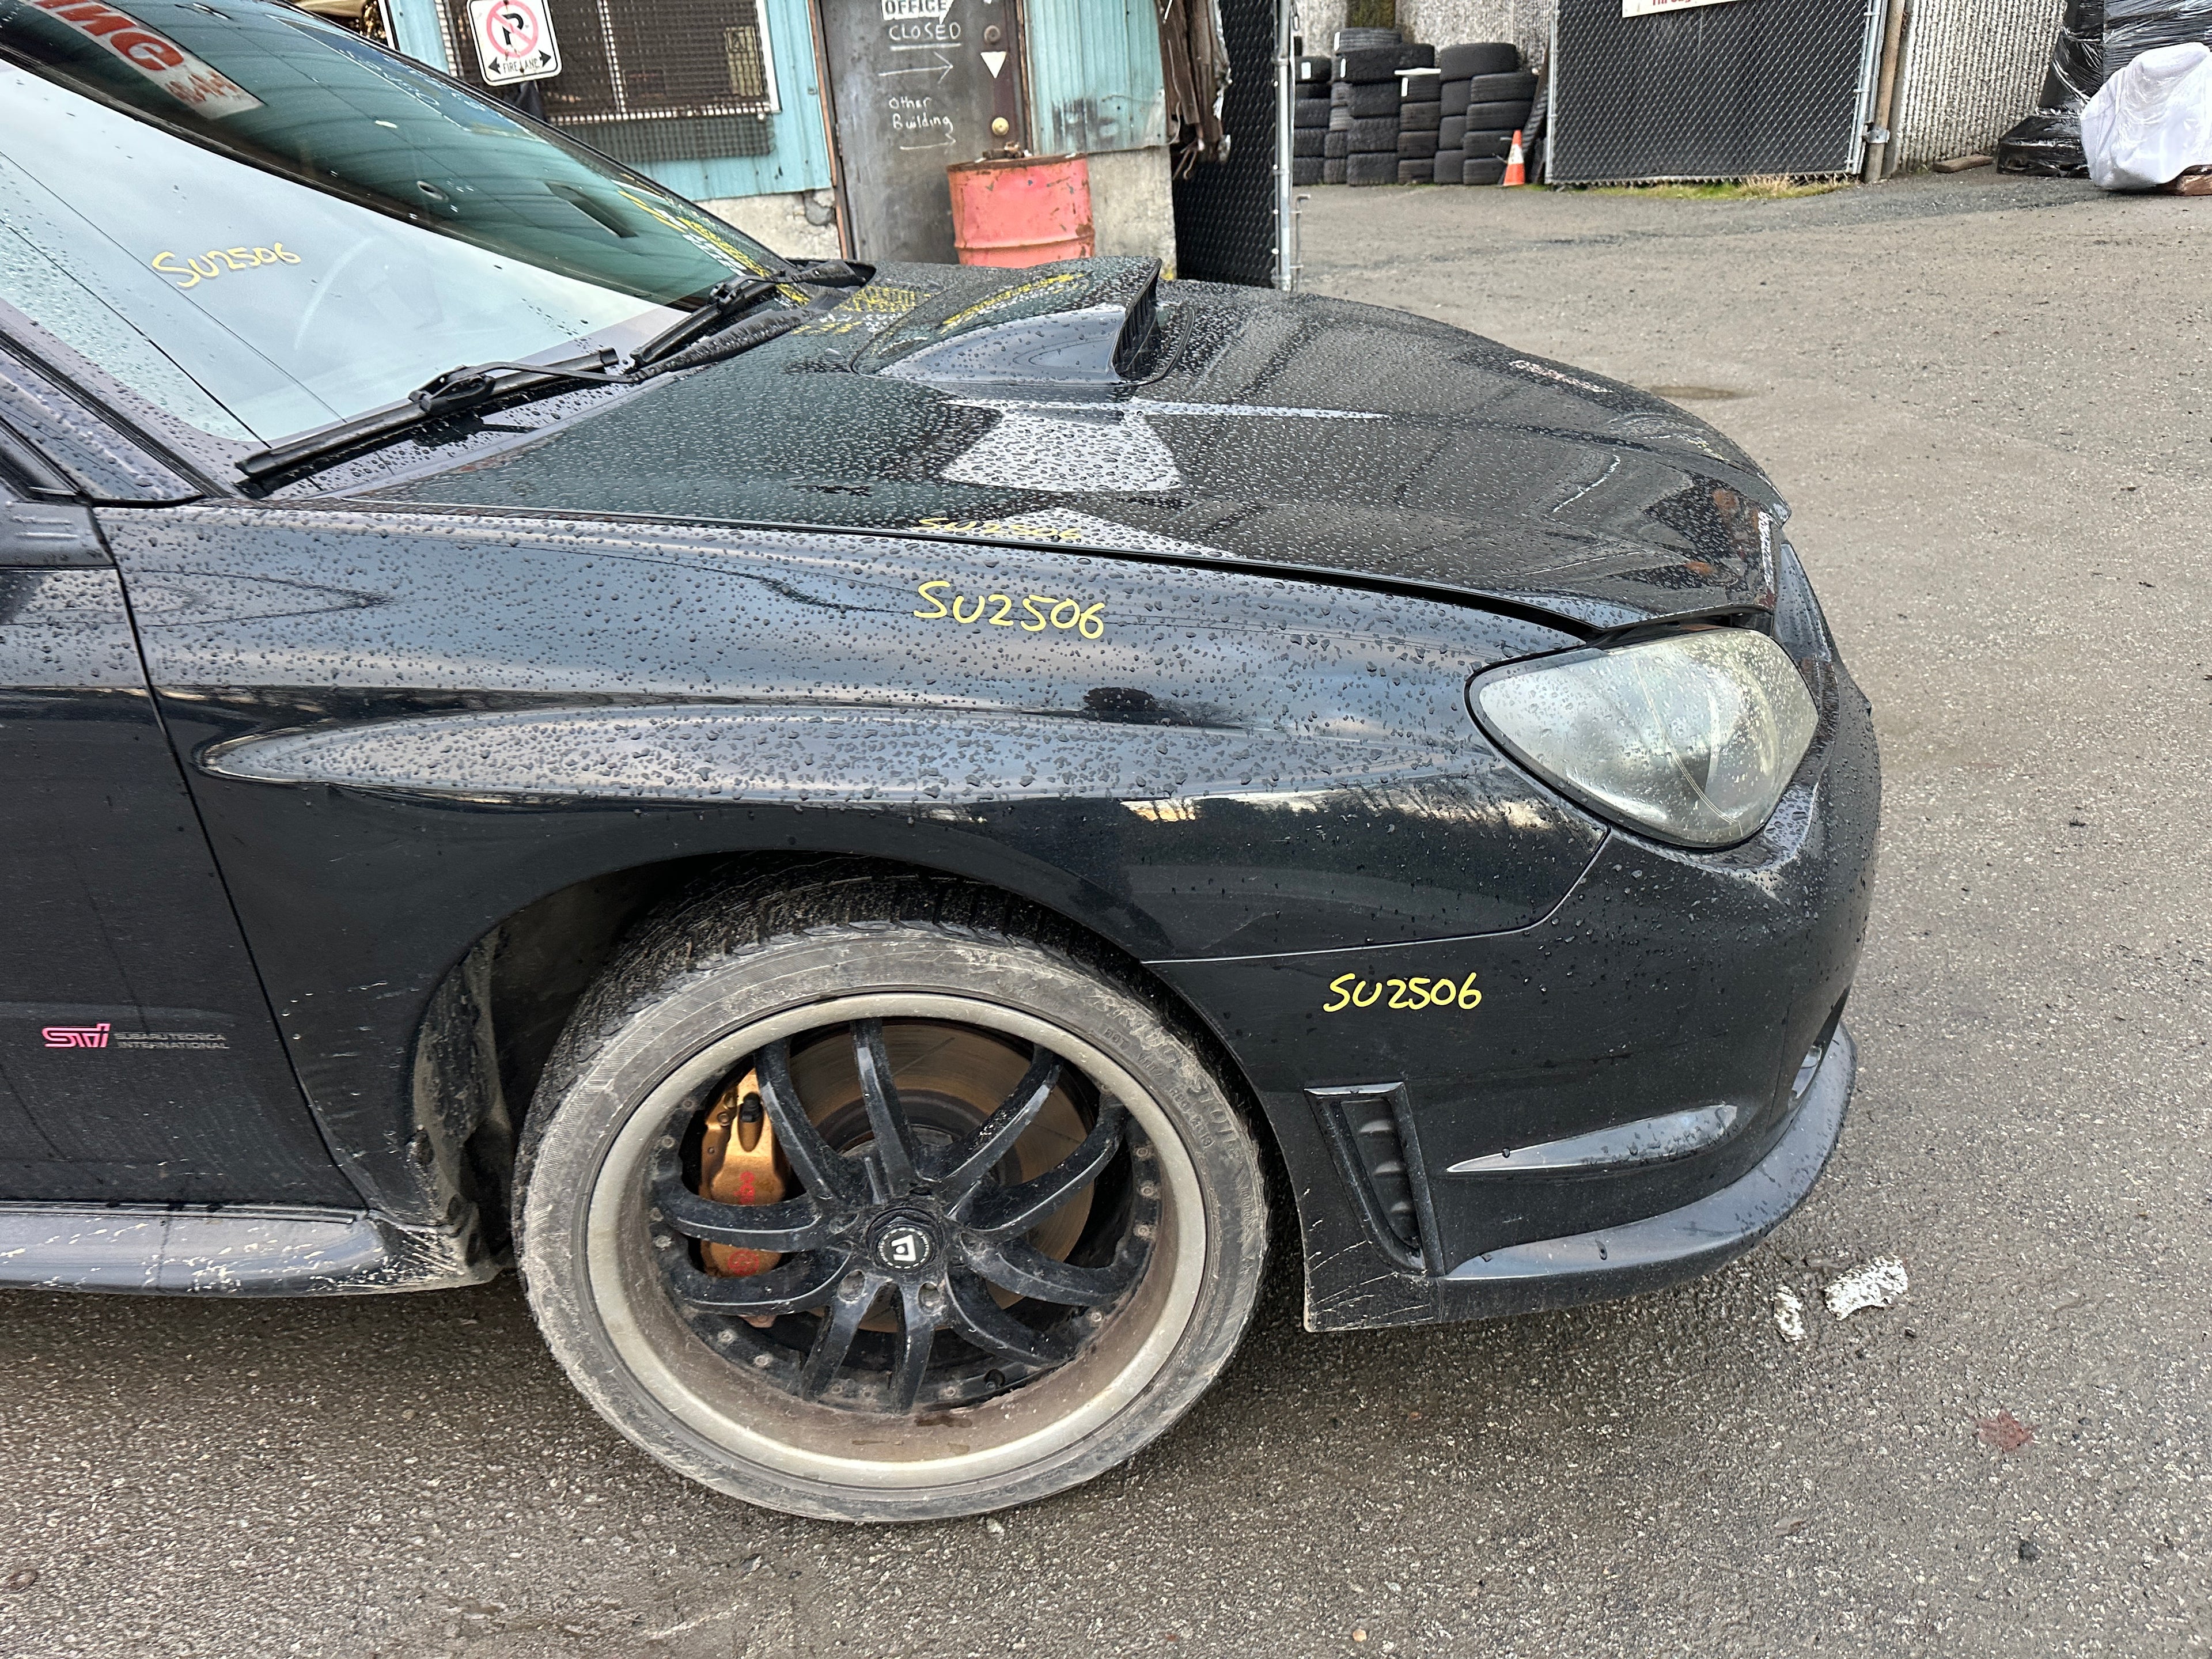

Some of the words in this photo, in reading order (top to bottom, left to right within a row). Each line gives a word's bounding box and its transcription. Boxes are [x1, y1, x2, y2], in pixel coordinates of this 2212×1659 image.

[889, 22, 961, 41] CLOSED
[503, 60, 518, 73] FIRE
[520, 58, 540, 70] LANE
[889, 96, 931, 110] Other
[893, 112, 953, 132] Building
[151, 243, 301, 287] SU2506
[912, 518, 1082, 539] SU2506
[914, 580, 1105, 639] SU2506
[1323, 972, 1482, 1012] SU2506
[117, 1041, 230, 1049] INTERNATIONAL
